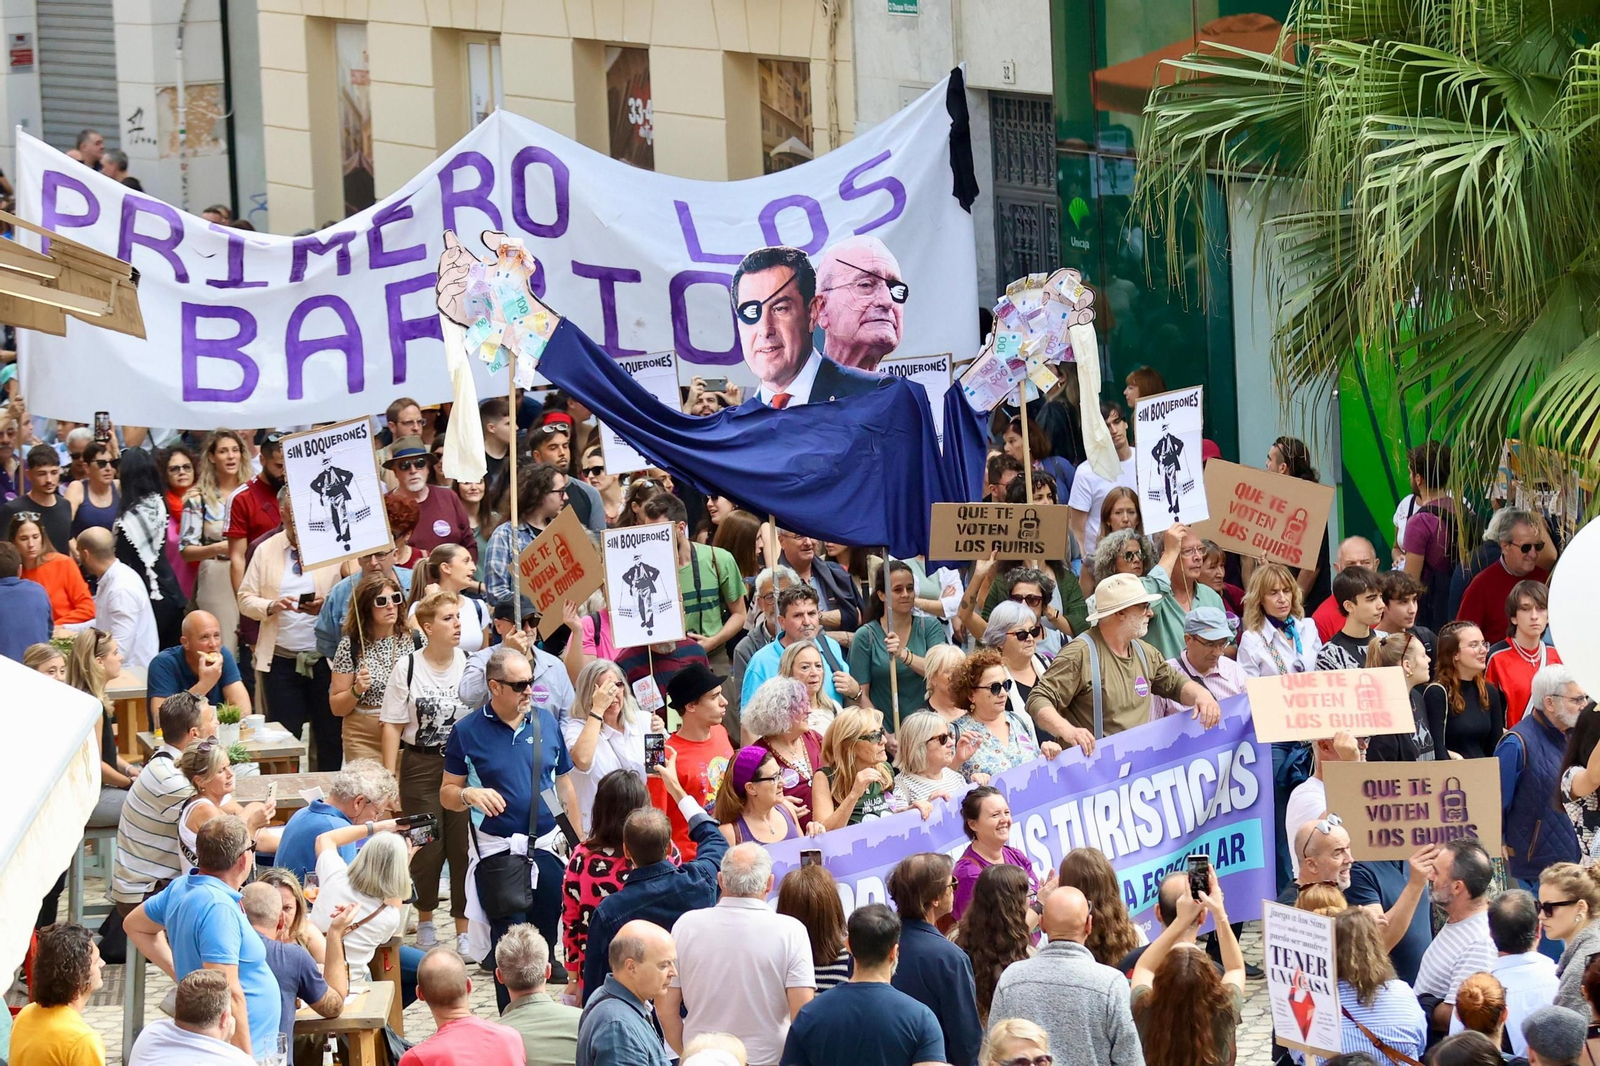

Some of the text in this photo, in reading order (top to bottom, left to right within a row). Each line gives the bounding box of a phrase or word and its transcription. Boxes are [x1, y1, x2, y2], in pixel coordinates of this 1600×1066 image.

[1003, 66, 1010, 79] 32
[41, 146, 906, 288] PRIMERO LOS
[516, 295, 529, 314] 100
[475, 317, 487, 329] 100
[997, 336, 1008, 354] 100
[1045, 335, 1058, 355] 500
[980, 359, 998, 376] 500
[989, 368, 1008, 385] 500
[1138, 391, 1198, 422] SIN BOQUERONES
[287, 423, 368, 459] SIN BOQUERONES
[1234, 482, 1288, 514] QUE TE
[957, 506, 1014, 520] QUE TE
[1229, 500, 1277, 531] VOTEN
[607, 528, 670, 549] SIN BOQUERONES
[956, 523, 1008, 535] VOTEN
[955, 540, 1045, 554] LOS GUIRIS
[1219, 518, 1303, 565] LOS GUIRIS
[520, 541, 552, 578] QUE TE
[528, 561, 559, 593] VOTEN
[536, 562, 585, 612] LOS GUIRIS
[1280, 672, 1347, 691] QUE TE
[1282, 692, 1345, 709] VOTEN
[1285, 711, 1394, 729] LOS GUIRIS
[1362, 778, 1432, 800] QUE TE
[1050, 741, 1259, 860] TURÍSTICAS
[1366, 802, 1429, 823] VOTEN
[1368, 827, 1405, 848] LOS
[1270, 944, 1328, 979] TENER
[1270, 967, 1330, 996] UNA CASA
